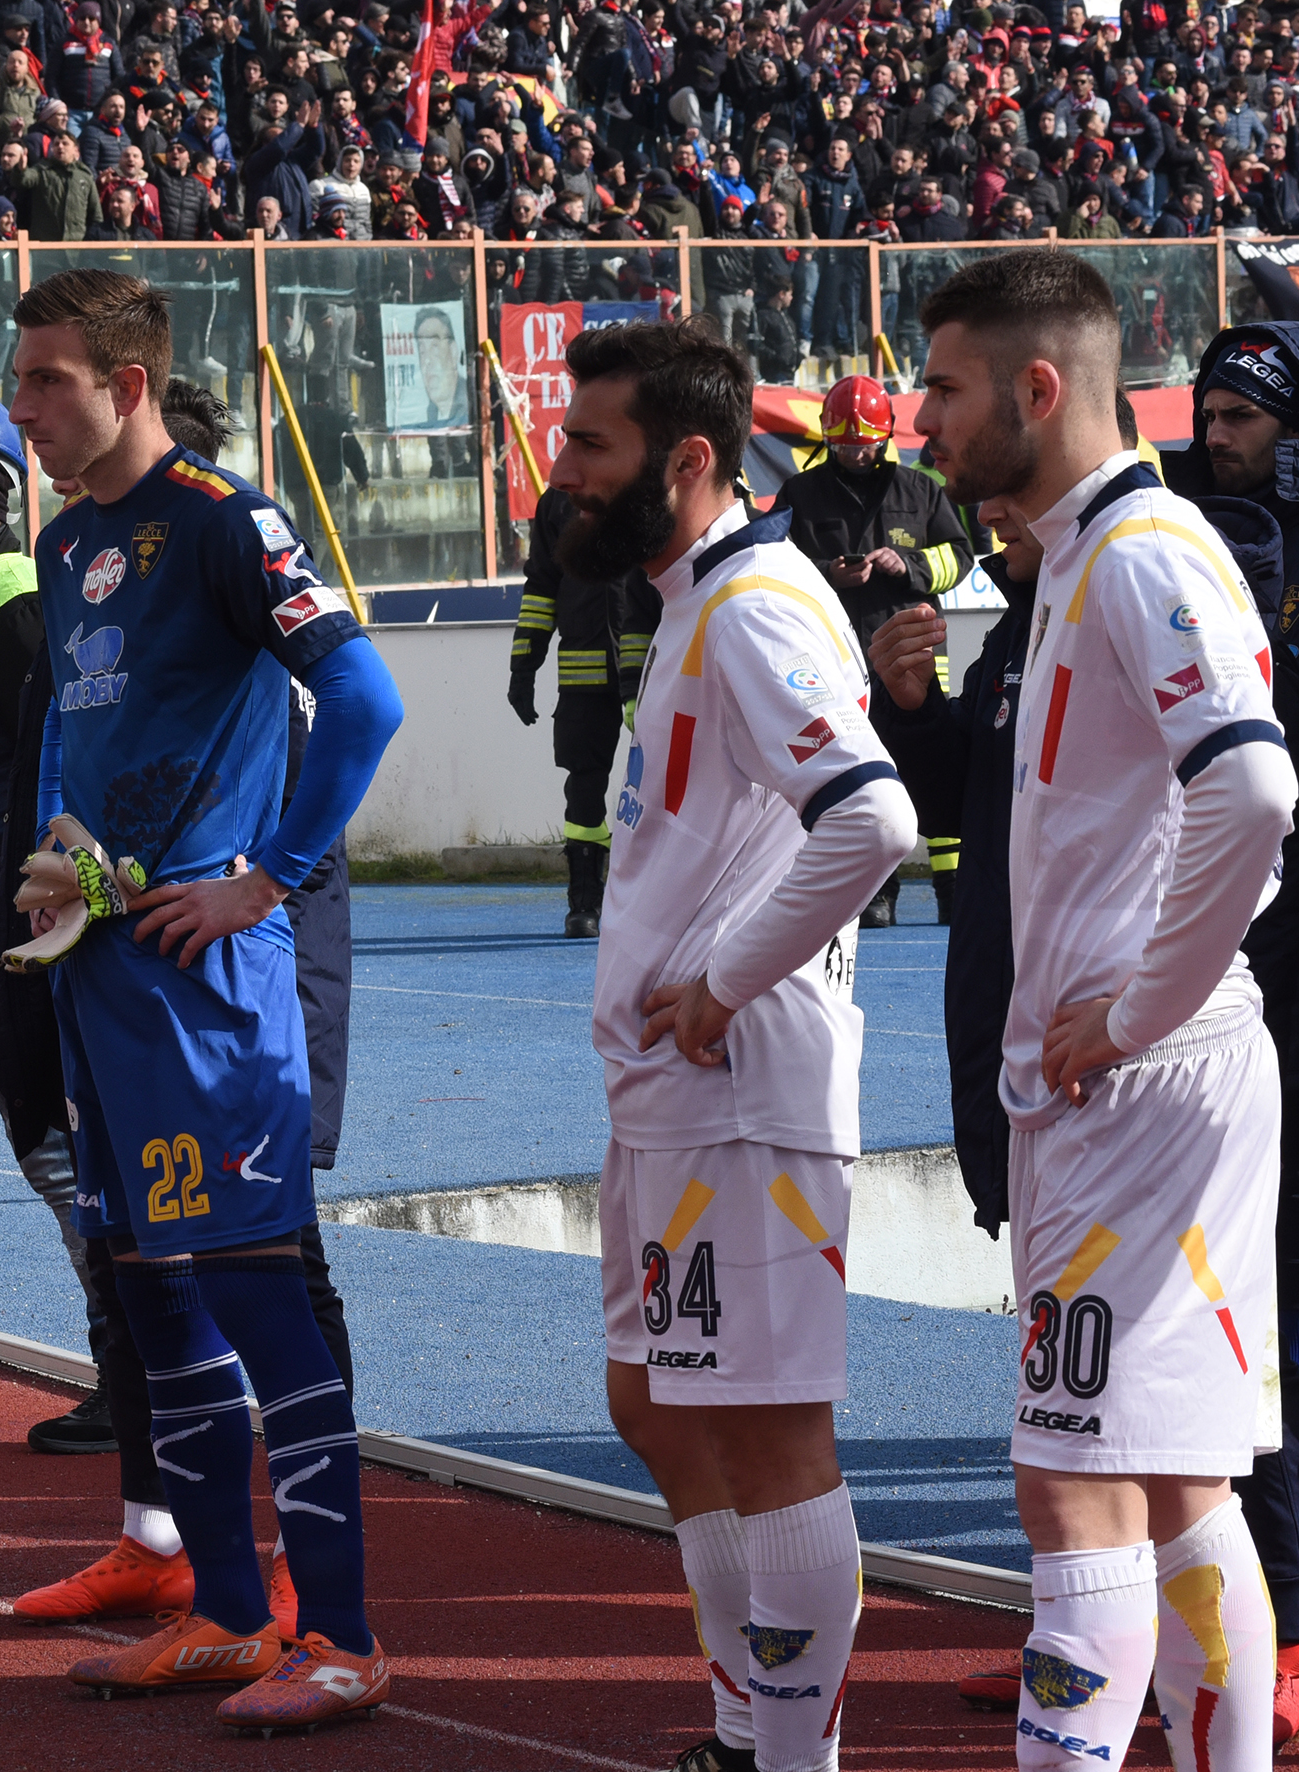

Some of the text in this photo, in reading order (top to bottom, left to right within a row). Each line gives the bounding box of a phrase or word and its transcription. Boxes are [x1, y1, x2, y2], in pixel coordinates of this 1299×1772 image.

[1224, 351, 1295, 399] LEGEA
[137, 528, 162, 537] LECCE
[60, 672, 129, 712] MOBY
[616, 790, 645, 831] OBY
[141, 1132, 211, 1223] 22
[641, 1240, 722, 1337] 34
[646, 1348, 718, 1369] LEGEA
[1024, 1289, 1113, 1400] 30
[1018, 1404, 1101, 1436] LEGEA
